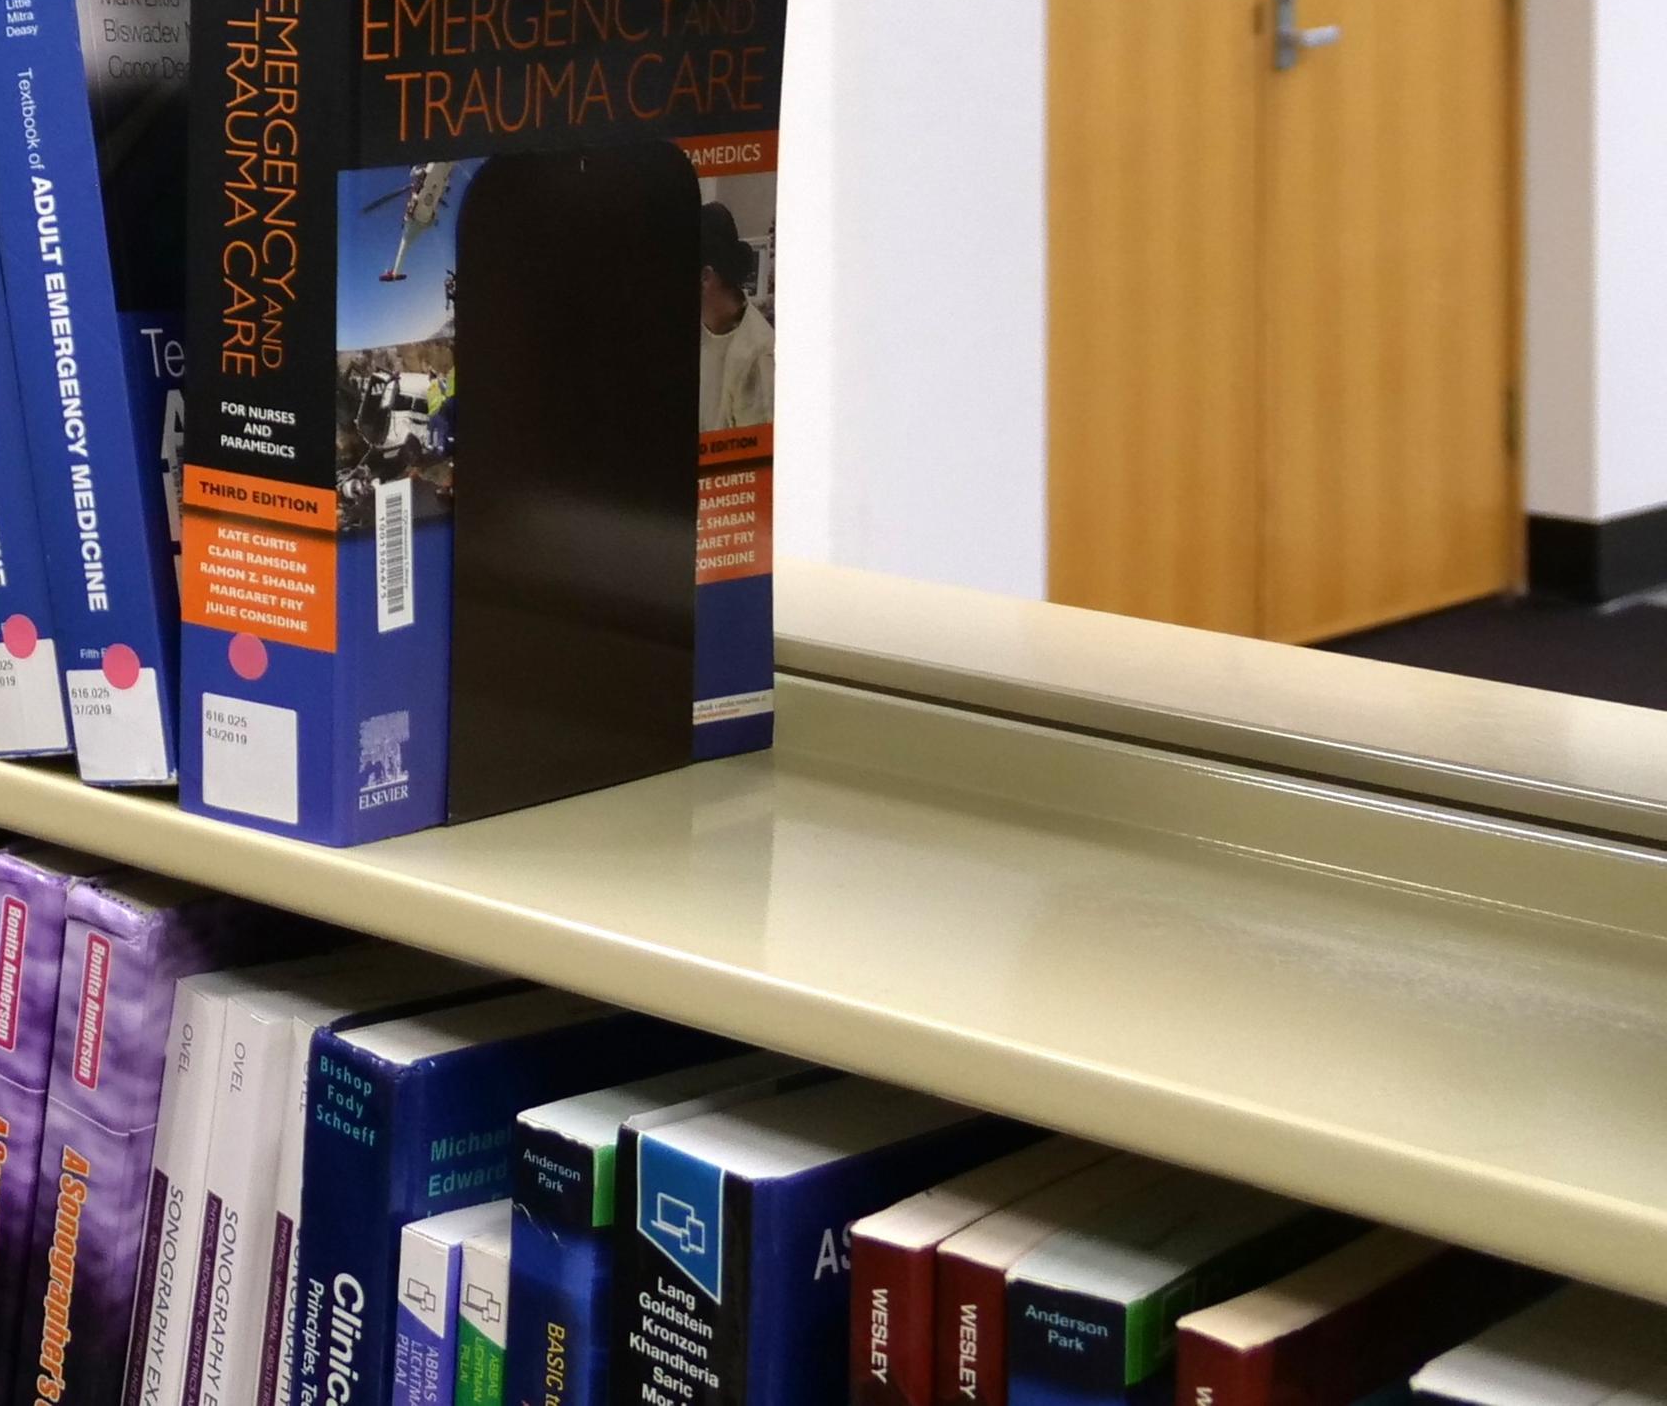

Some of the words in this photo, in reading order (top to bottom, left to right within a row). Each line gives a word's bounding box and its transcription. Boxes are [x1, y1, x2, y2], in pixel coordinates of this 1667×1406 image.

[5, 22, 38, 39] Deasy
[6, 9, 34, 24] Mitra
[16, 67, 42, 150] Textbook
[385, 58, 615, 143] TRAUMA
[626, 46, 767, 120] CARE
[222, 7, 260, 228] TRAUMA
[28, 152, 45, 171] of
[30, 175, 63, 267] ADULT
[221, 239, 258, 378] CARE
[261, 294, 284, 370] AND
[45, 269, 88, 460] EMERGENCY
[220, 400, 245, 420] FOR
[247, 405, 297, 425] NURSES
[243, 420, 272, 437] AND
[220, 433, 296, 459] PARAMEDICS
[199, 479, 248, 505] THIRD
[251, 489, 319, 515] EDITION
[70, 463, 110, 614] MEDICINE
[217, 527, 249, 544] KATE
[251, 532, 298, 553] CURTIS
[205, 600, 238, 618] JULIE
[239, 607, 308, 633] CONSIDINE
[73, 702, 112, 717] 37/2019
[359, 786, 410, 810] ELSEVIER
[2, 902, 24, 960] Bonita
[176, 1023, 194, 1074] OVEL
[319, 1054, 373, 1097] Bishop
[326, 1083, 365, 1121] Fody
[315, 1102, 376, 1148] Schoeff
[37, 1176, 88, 1402] Sonographer's
[205, 1207, 240, 1380] SONOGRAPHY
[656, 1274, 696, 1312] Lang
[638, 1292, 714, 1340] Goldstein
[641, 1315, 708, 1358] Kronzon
[870, 1288, 889, 1387] WESLEY
[1024, 1303, 1110, 1338] Anderson
[628, 1332, 720, 1391] Khandheria
[1047, 1326, 1086, 1354] Park
